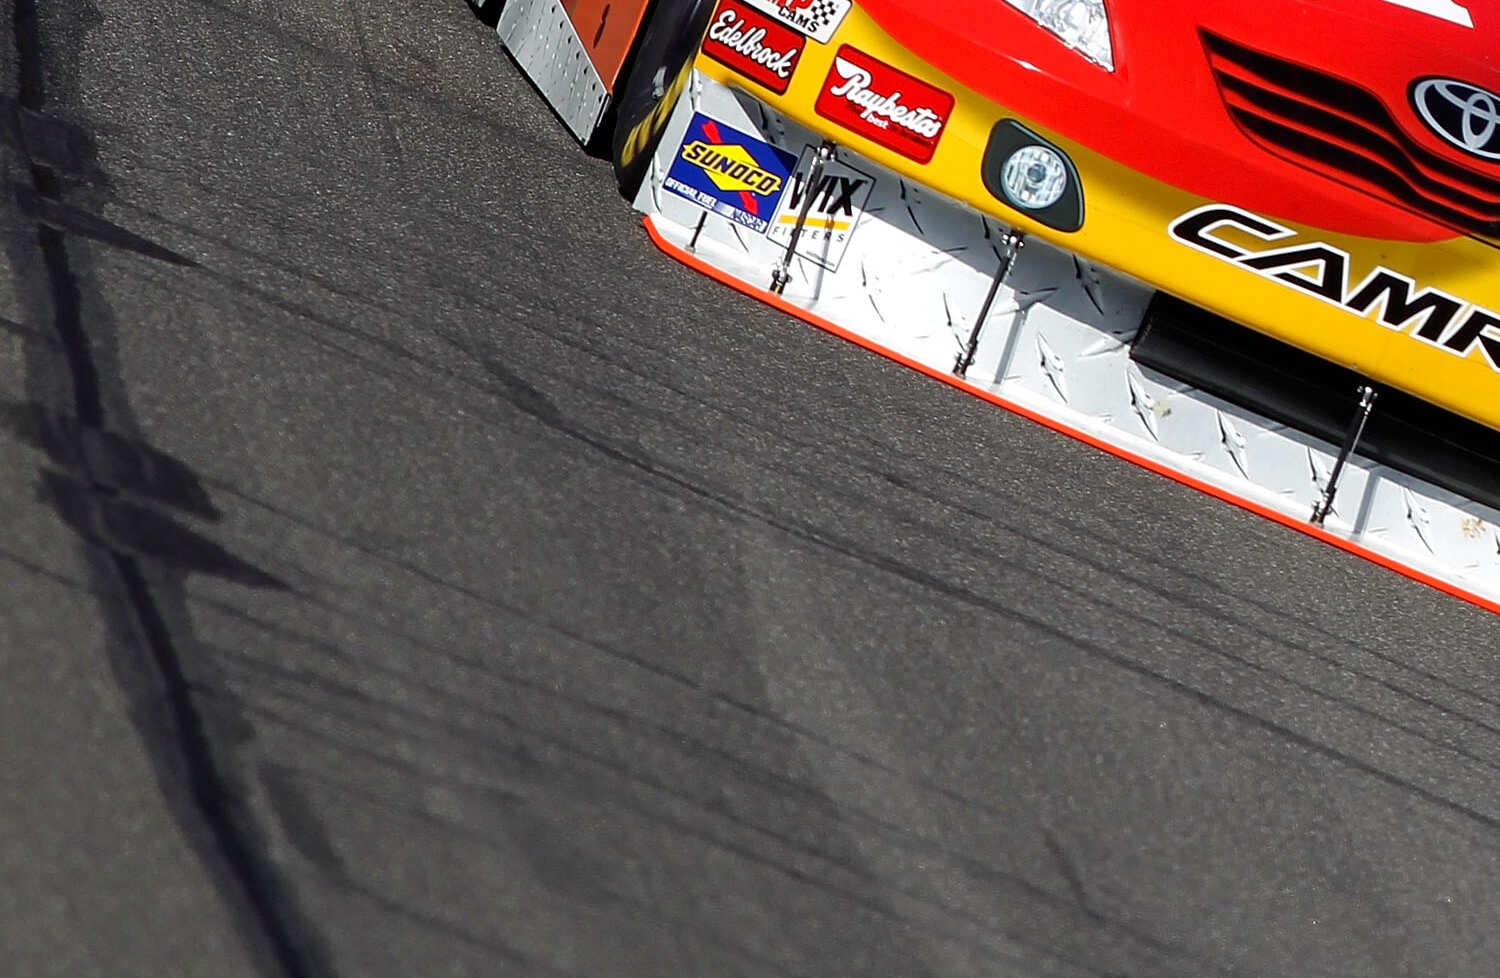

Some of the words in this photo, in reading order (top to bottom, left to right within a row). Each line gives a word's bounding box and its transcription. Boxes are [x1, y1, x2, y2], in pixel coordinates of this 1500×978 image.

[777, 2, 822, 35] CAMS
[708, 10, 791, 79] Edelbrock
[684, 142, 778, 196] SUNOCO
[789, 172, 867, 217] WIX
